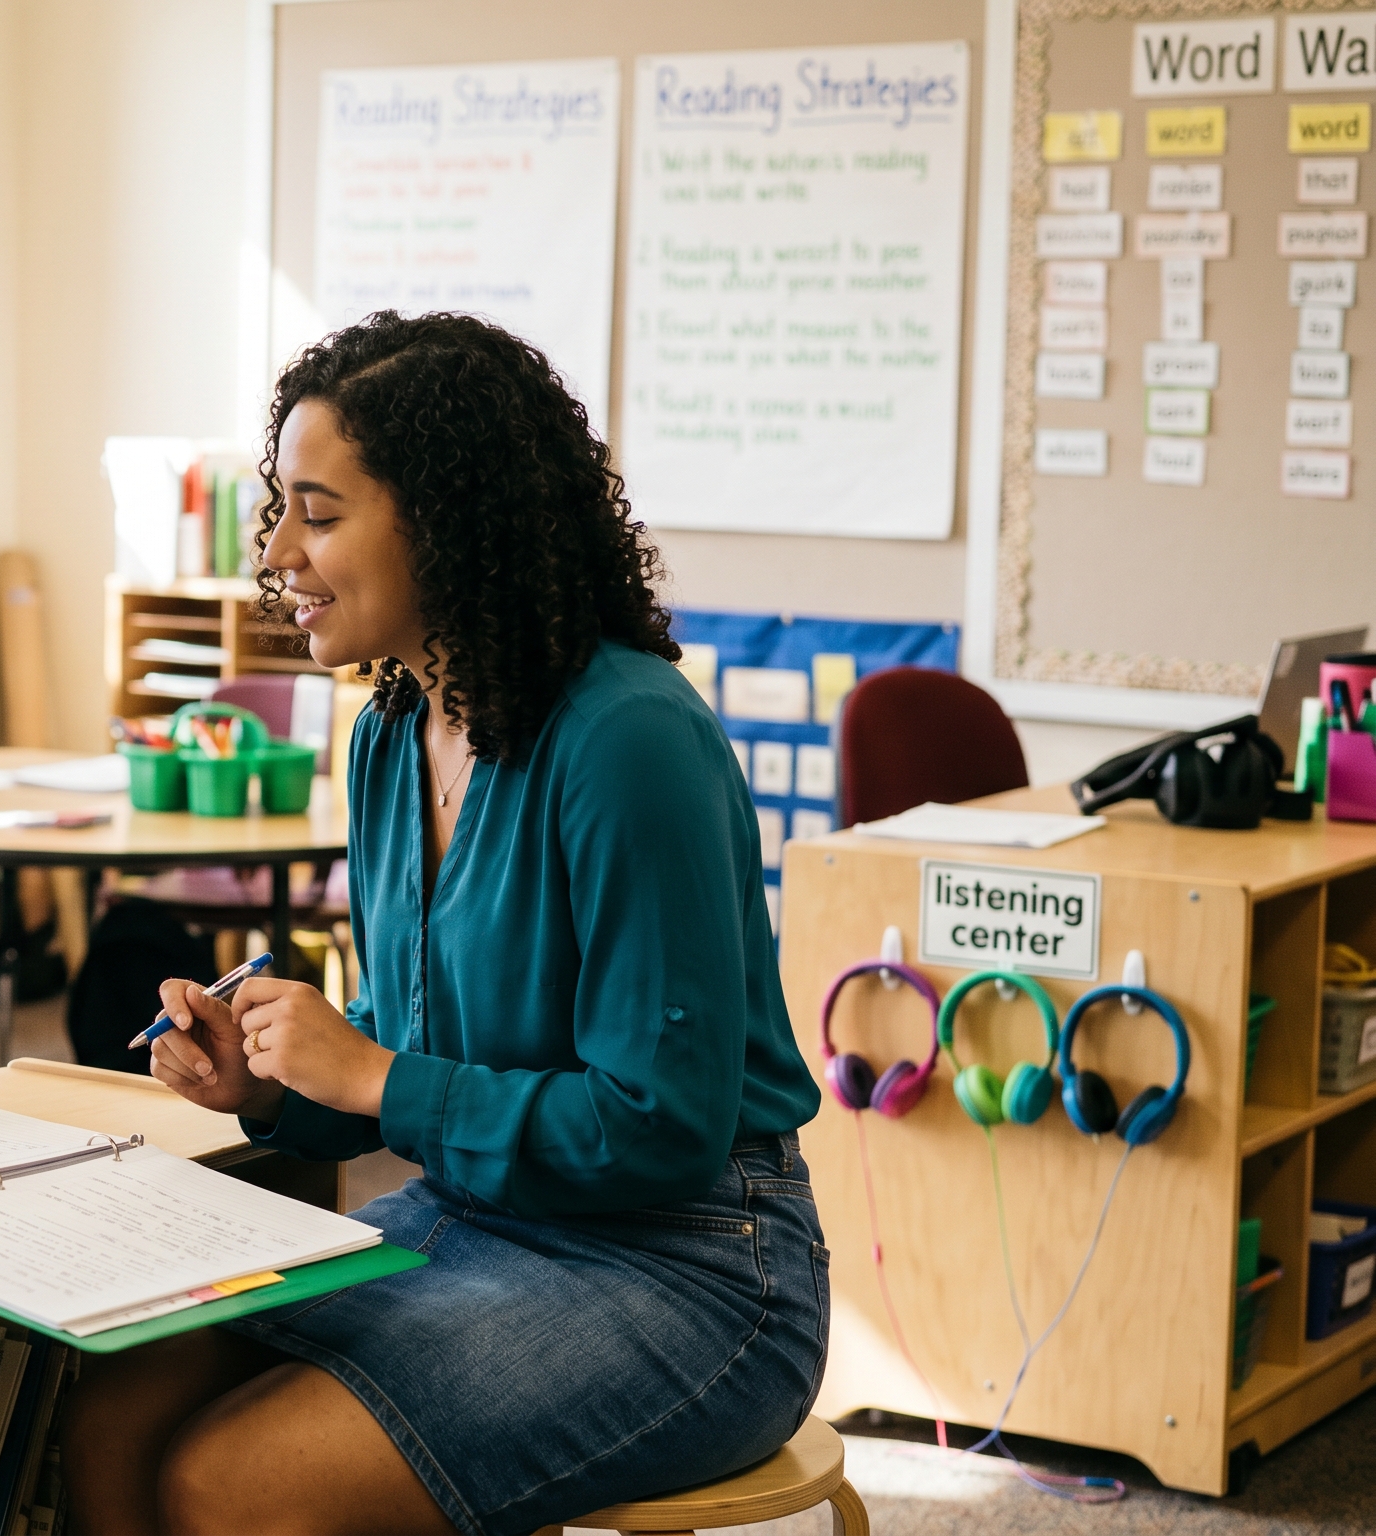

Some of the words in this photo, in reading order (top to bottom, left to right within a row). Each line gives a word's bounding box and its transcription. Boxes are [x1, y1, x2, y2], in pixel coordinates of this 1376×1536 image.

[1142, 30, 1262, 82] Word
[1298, 26, 1376, 76] Wa
[333, 80, 443, 146] Reading
[450, 73, 605, 142] Strategies
[655, 65, 782, 136] Reading
[795, 58, 959, 130] Strategies
[1156, 119, 1215, 143] word
[1299, 113, 1360, 139] word
[1304, 168, 1350, 190] that
[935, 872, 1084, 927] listening
[951, 924, 1065, 957] center
